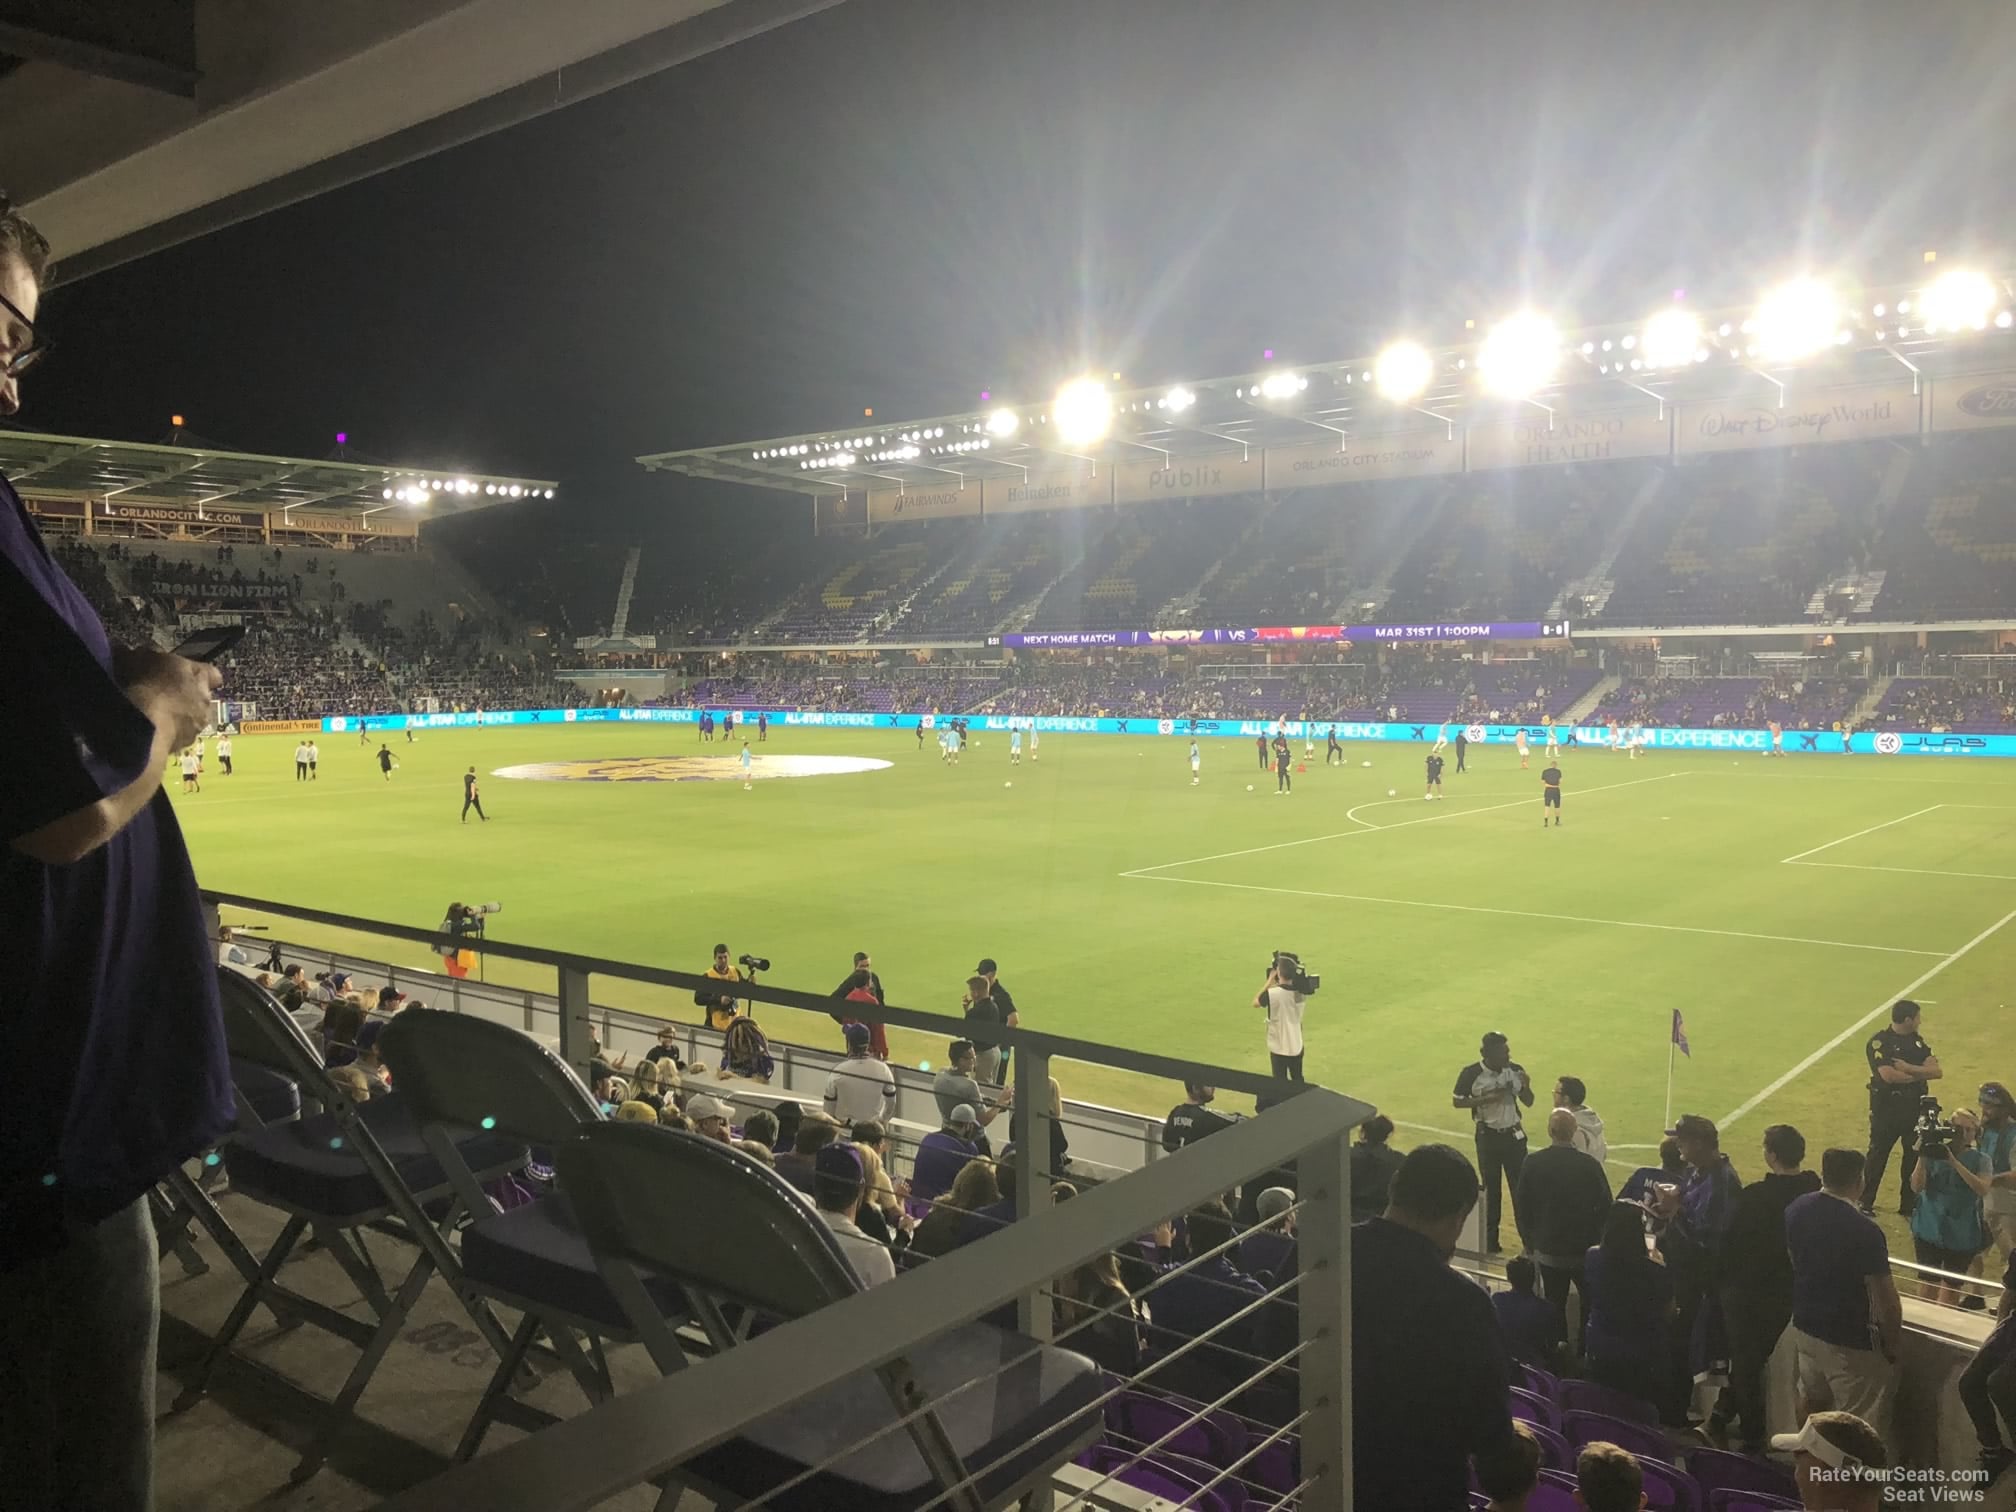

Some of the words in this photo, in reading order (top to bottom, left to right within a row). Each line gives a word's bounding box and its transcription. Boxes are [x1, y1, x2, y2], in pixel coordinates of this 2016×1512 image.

[1832, 401, 1892, 421] World
[1293, 455, 1350, 472] ORLANDO
[1353, 453, 1379, 467] CITY
[1382, 449, 1434, 465] STADIUM
[1150, 467, 1222, 489] Publix
[903, 493, 957, 508] FAIRWINDS
[1008, 485, 1070, 502] Heineken
[120, 507, 241, 523] ORLANDOCITYC.COM
[152, 581, 198, 596] IRON
[201, 583, 243, 597] LION
[246, 585, 288, 597] FIRM
[1228, 630, 1246, 641] VS
[1375, 627, 1403, 637] MAR
[1405, 627, 1434, 637] 31ST
[1443, 625, 1490, 636] 1:00PM
[1023, 636, 1048, 644] NEXT
[1051, 635, 1078, 644] HOME
[1081, 634, 1116, 643] MATCH
[652, 710, 693, 721] EXPERIENCE
[826, 713, 875, 725] EXPERIENCE
[243, 722, 292, 733] Continental
[302, 721, 319, 729] TIRE
[1036, 718, 1098, 731] EXPERIENCE
[1660, 729, 1767, 747] EXPERIENCE
